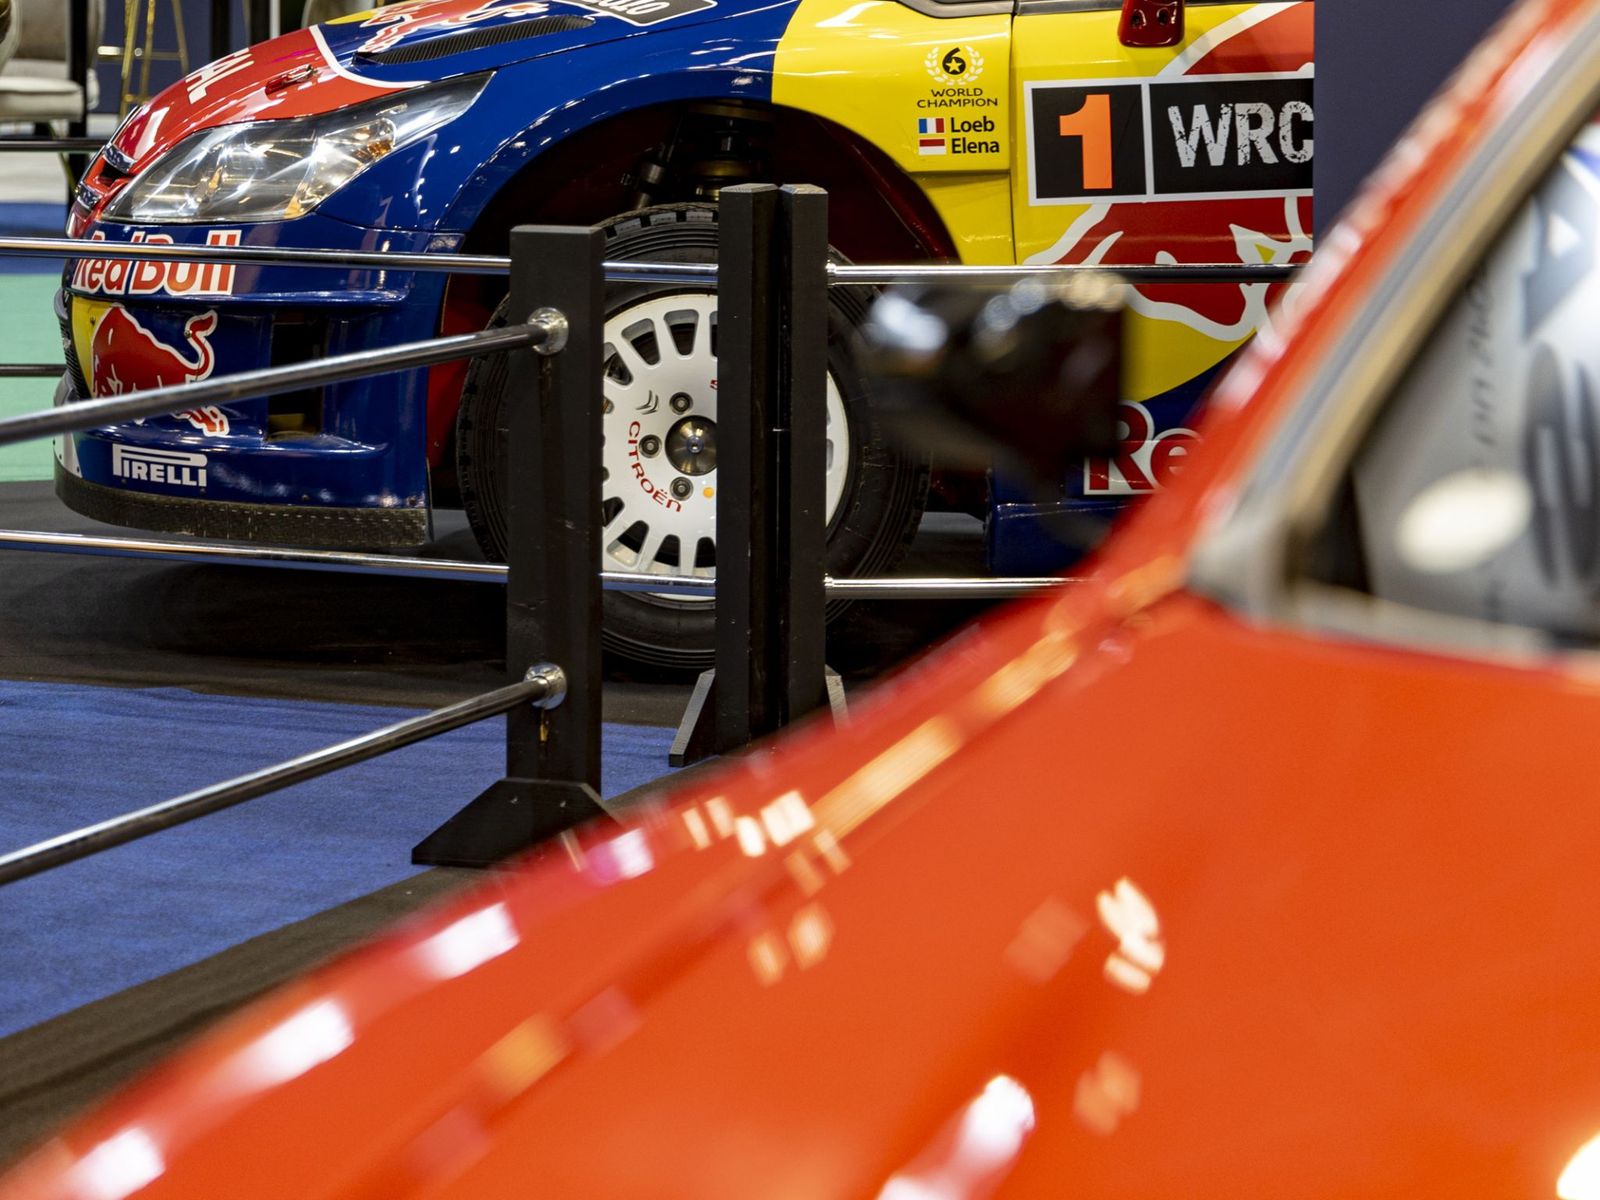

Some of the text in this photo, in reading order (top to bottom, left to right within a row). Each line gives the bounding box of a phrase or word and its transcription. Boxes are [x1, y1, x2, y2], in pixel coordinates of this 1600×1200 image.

[942, 47, 966, 75] 6
[917, 98, 998, 109] CHAMPION
[931, 88, 983, 98] WORLD
[950, 116, 995, 133] Loeb
[1167, 100, 1315, 168] WRC
[951, 137, 1000, 154] Elena
[1059, 94, 1113, 190] 1
[112, 443, 208, 487] PIRELLI
